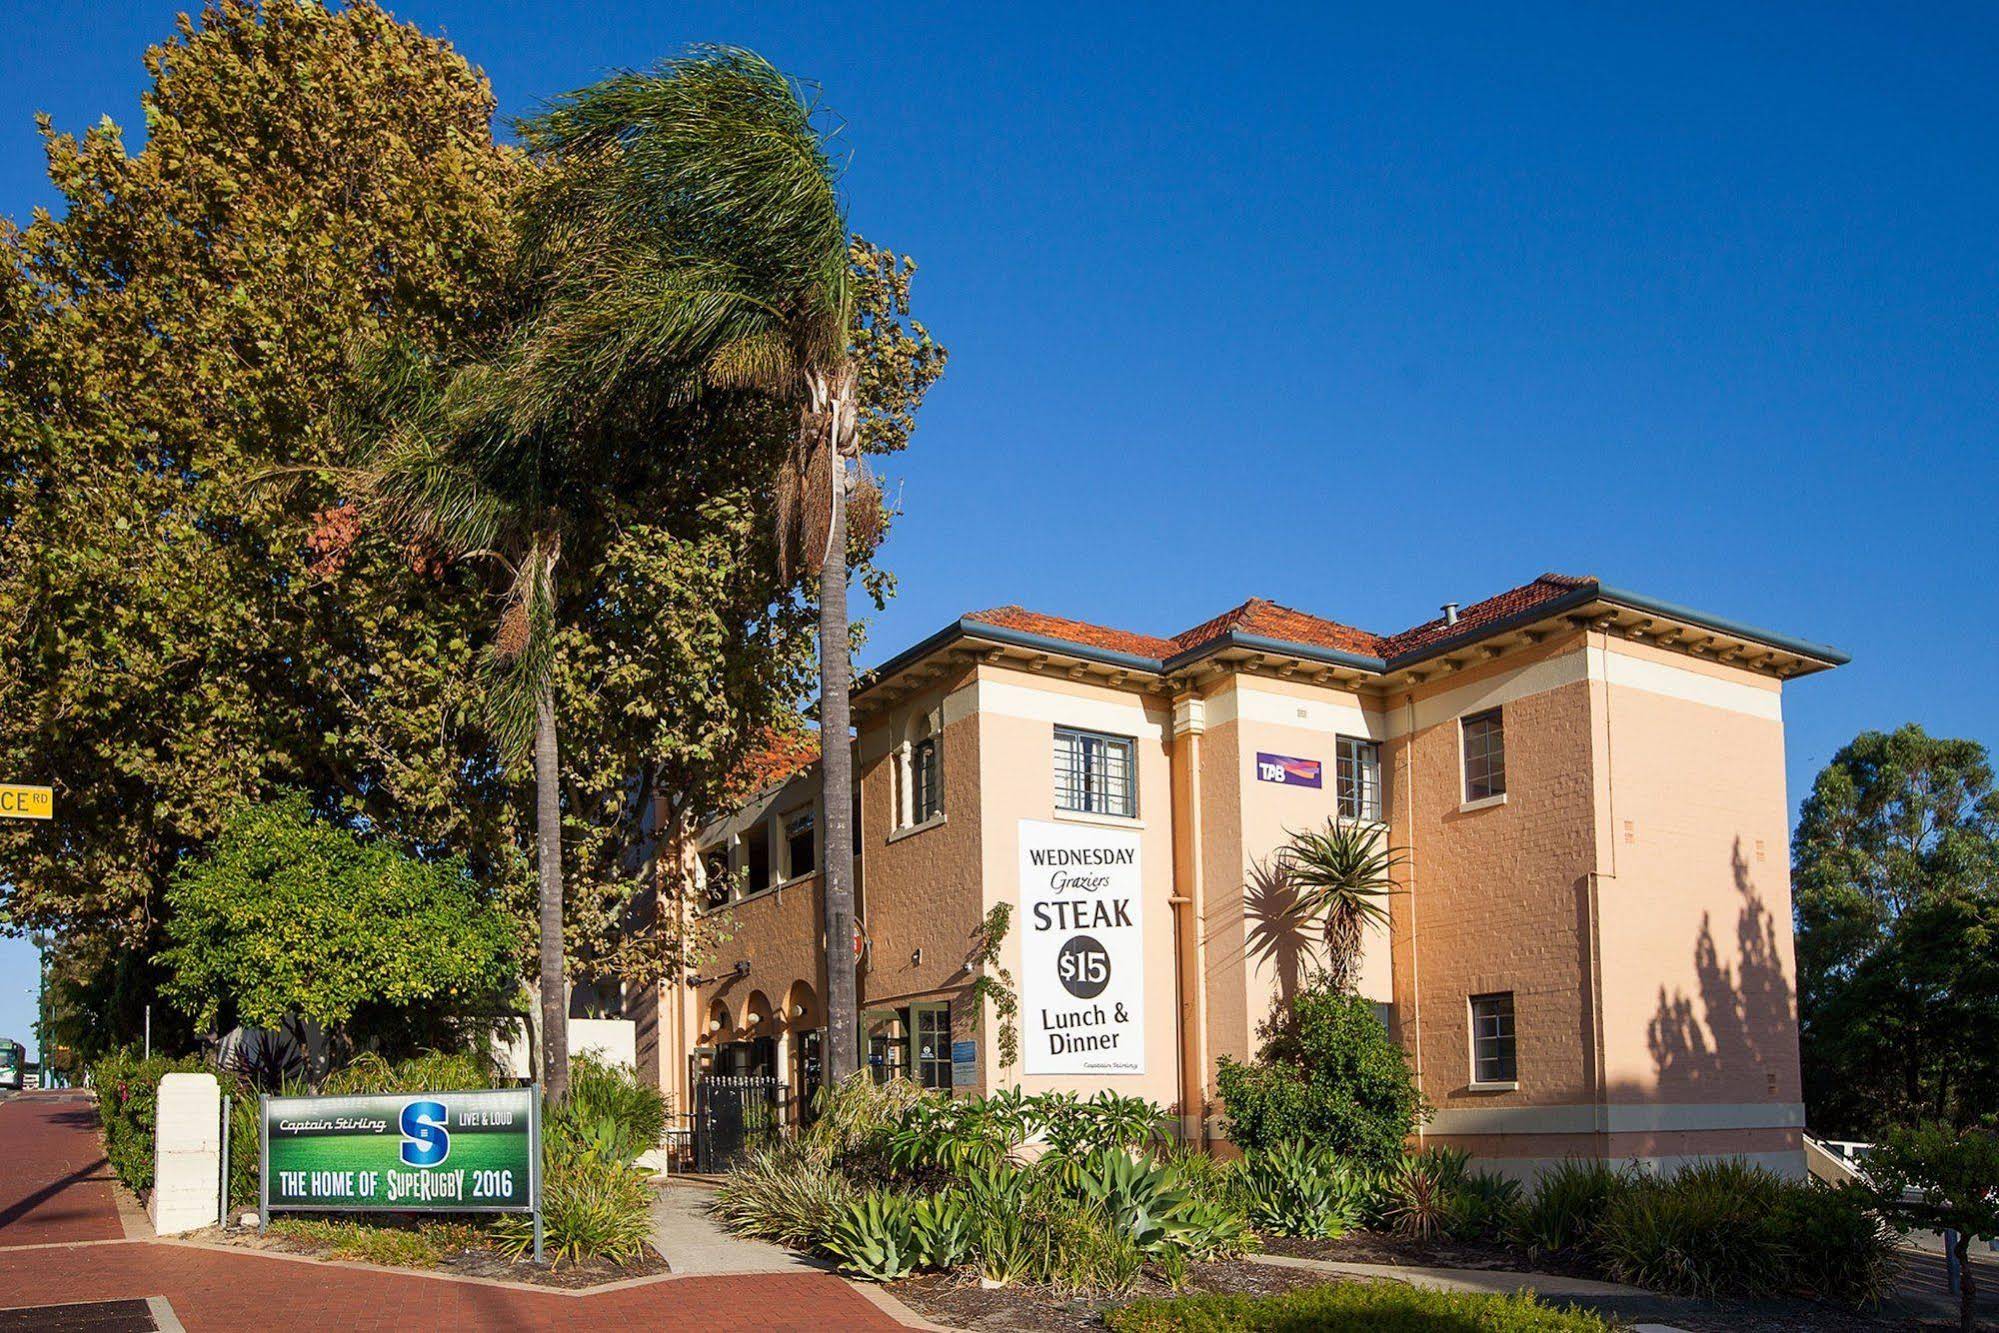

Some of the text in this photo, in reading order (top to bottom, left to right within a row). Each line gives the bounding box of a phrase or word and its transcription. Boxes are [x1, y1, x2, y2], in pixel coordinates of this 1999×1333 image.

[1259, 762, 1286, 782] TAB
[33, 793, 48, 804] RD
[1030, 848, 1135, 866] WEDNESDAY
[1050, 870, 1110, 894] Graziers
[1033, 899, 1133, 931] STEAK
[1059, 951, 1107, 983] $15
[1041, 1002, 1129, 1030] Lunch &
[1049, 1033, 1120, 1055] Dinner
[280, 1118, 387, 1134] Captain Stirling
[481, 1112, 488, 1126] &
[490, 1111, 513, 1126] LOUD
[280, 1171, 307, 1197] THE
[311, 1171, 355, 1197] HOME
[359, 1171, 378, 1197] OF
[472, 1170, 513, 1197] 2016
